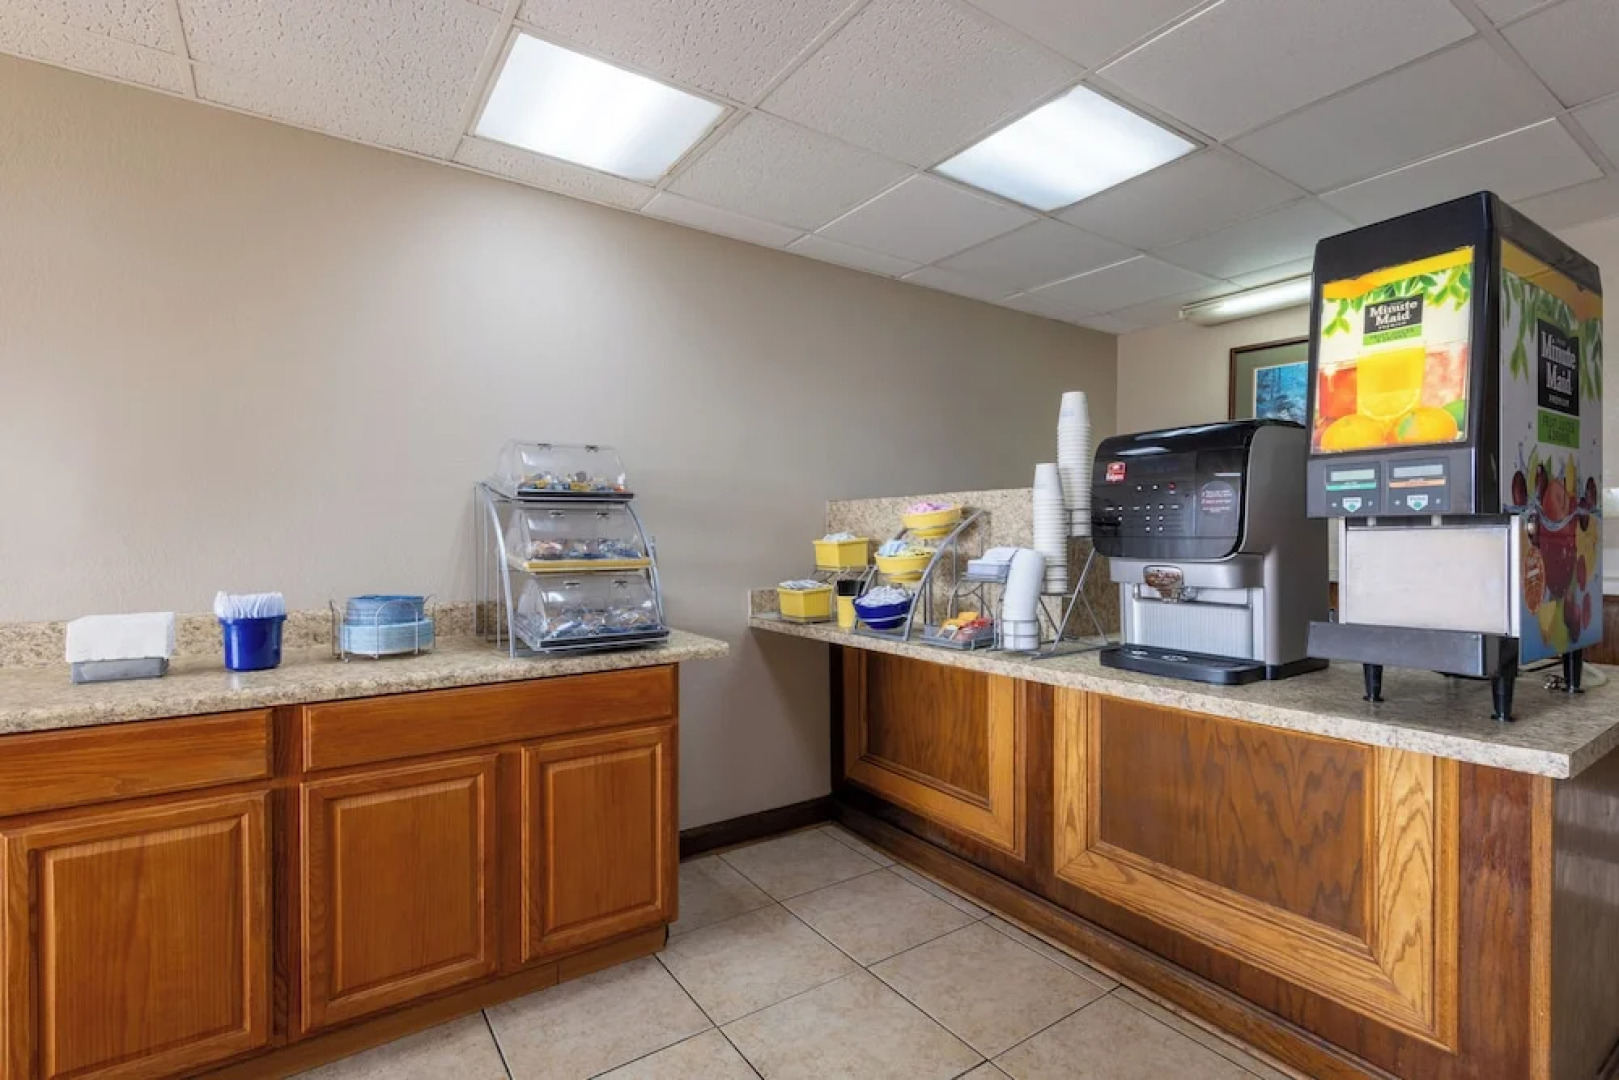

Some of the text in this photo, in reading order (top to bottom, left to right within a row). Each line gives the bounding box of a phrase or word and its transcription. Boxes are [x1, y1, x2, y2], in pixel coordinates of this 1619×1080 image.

[1369, 301, 1418, 318] Minute
[1375, 310, 1411, 326] Maid
[1541, 331, 1576, 370] Minute
[1545, 362, 1573, 395] Maid
